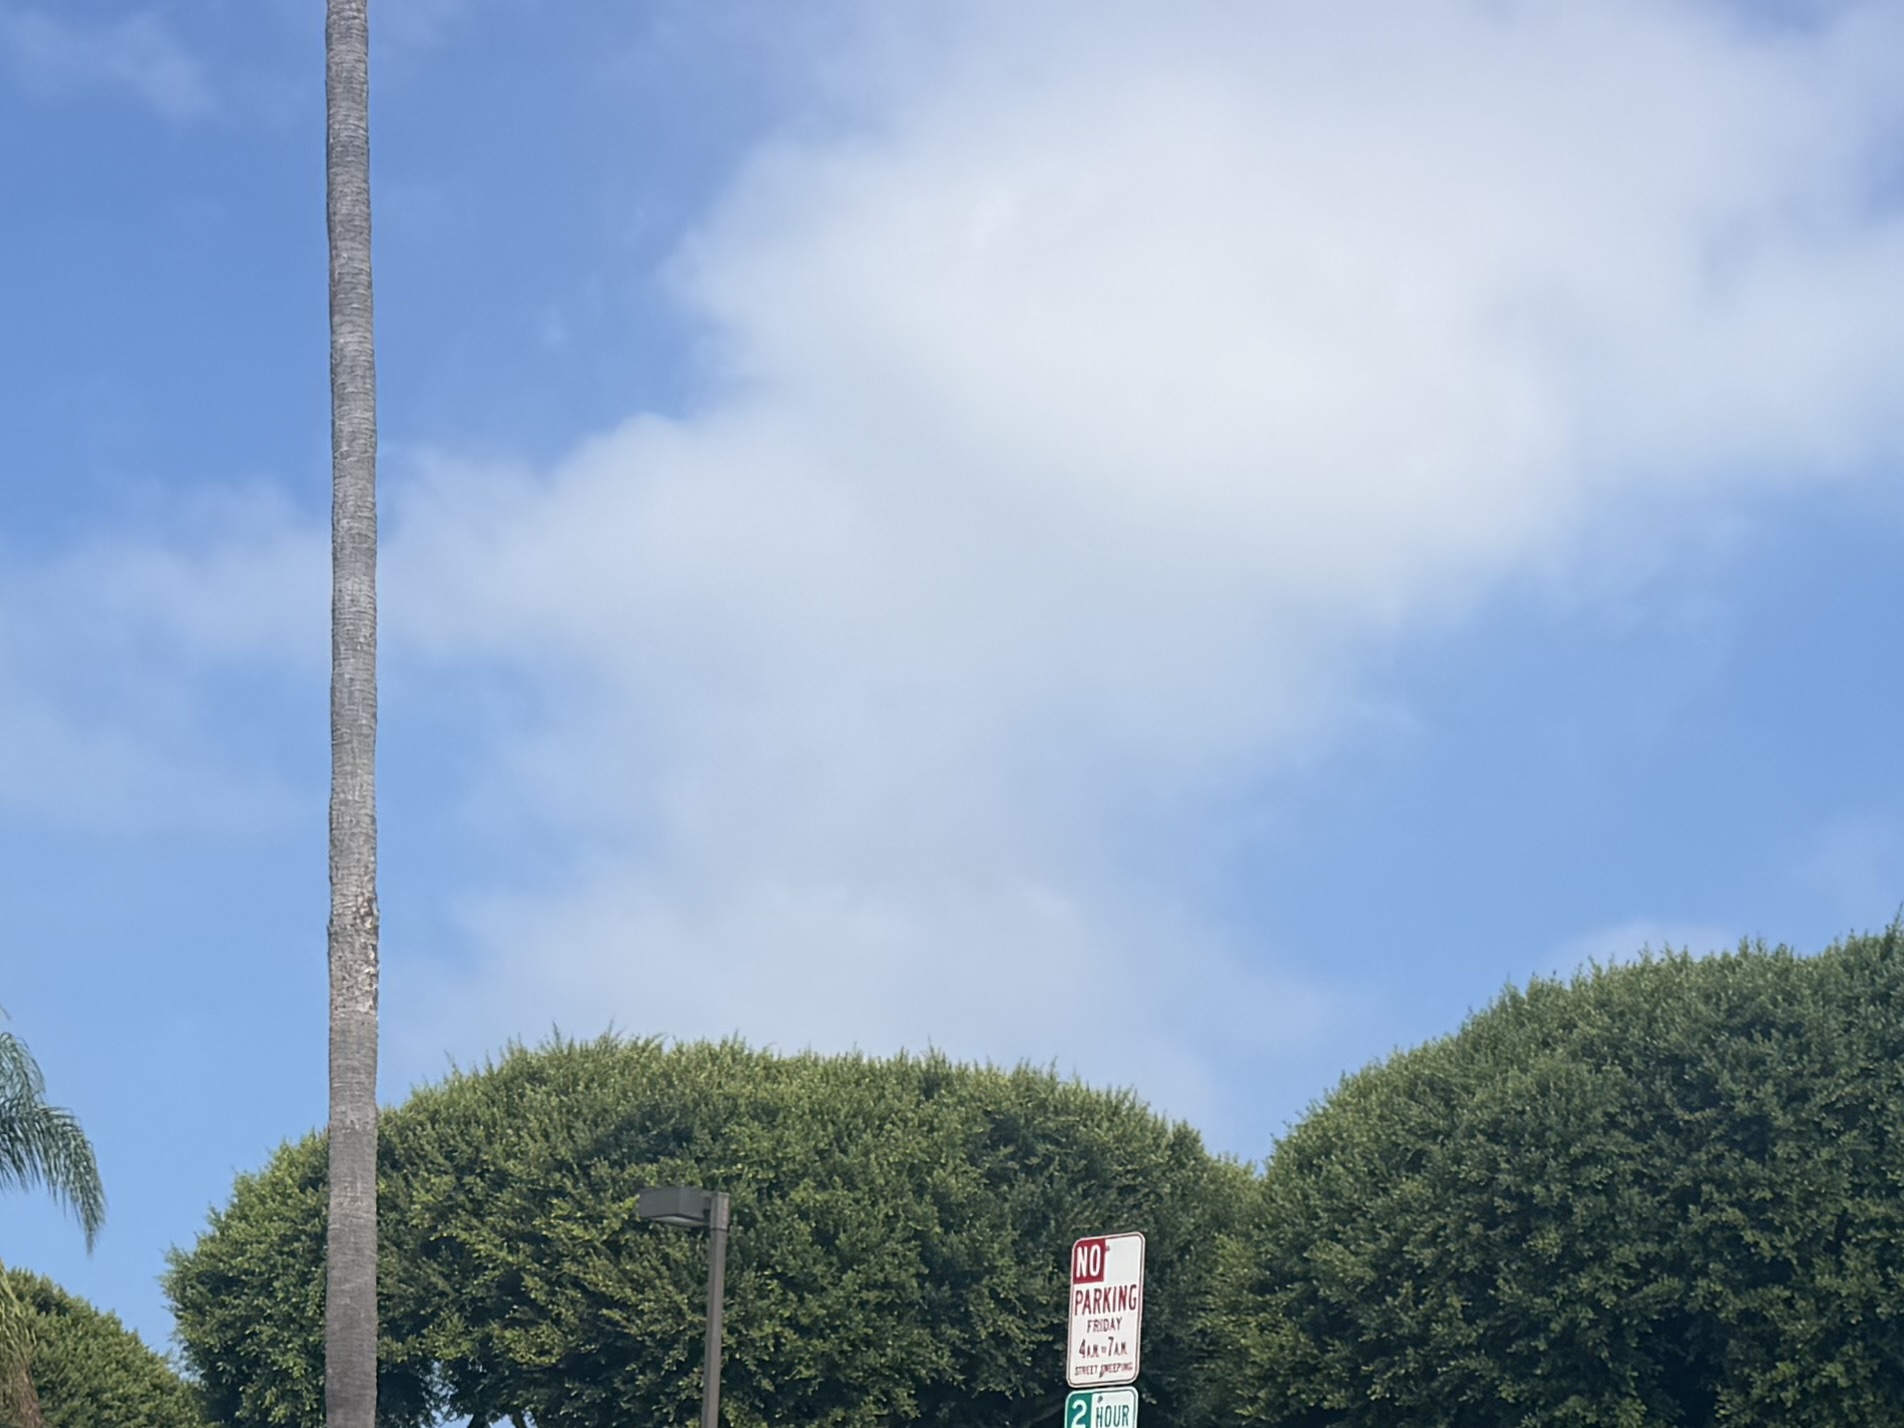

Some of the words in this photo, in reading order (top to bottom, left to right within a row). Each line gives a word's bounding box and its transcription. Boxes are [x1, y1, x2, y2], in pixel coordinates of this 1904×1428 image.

[1076, 1244, 1101, 1278] NO
[1075, 1284, 1137, 1316] PARKING
[1087, 1317, 1122, 1333] FRIDAY
[1075, 1365, 1098, 1376] STREET
[1099, 1362, 1133, 1375] SWEEPING
[1096, 1405, 1129, 1428] HOUR
